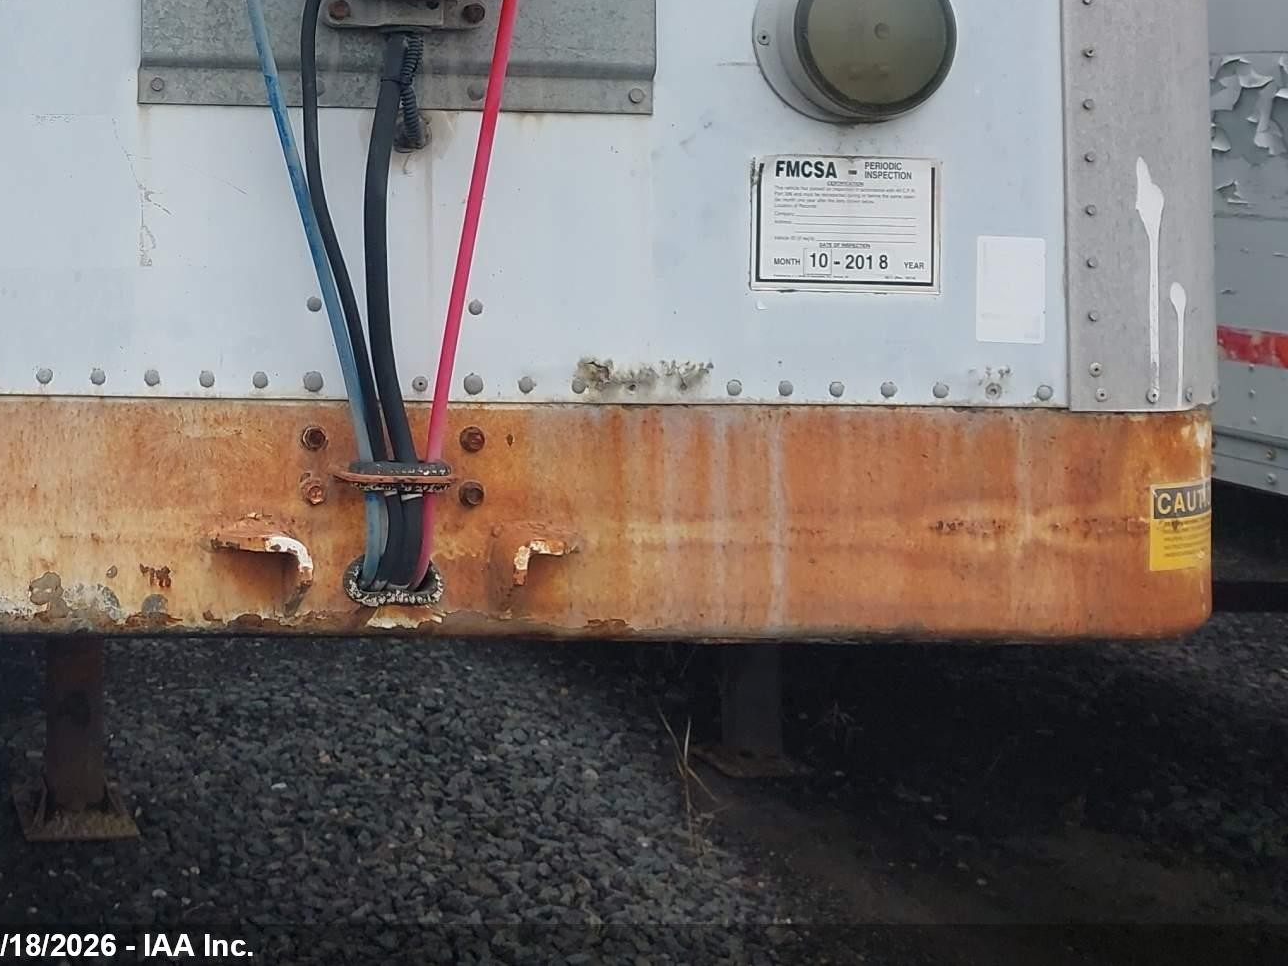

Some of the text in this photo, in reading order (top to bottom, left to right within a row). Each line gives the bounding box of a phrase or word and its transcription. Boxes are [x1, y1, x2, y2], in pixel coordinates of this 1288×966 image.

[775, 160, 838, 179] FMCSA
[864, 161, 902, 171] PERIODIC
[864, 171, 912, 180] INSPECTION
[773, 257, 801, 266] MONTH
[809, 253, 828, 268] 10
[903, 261, 925, 270] YEAR
